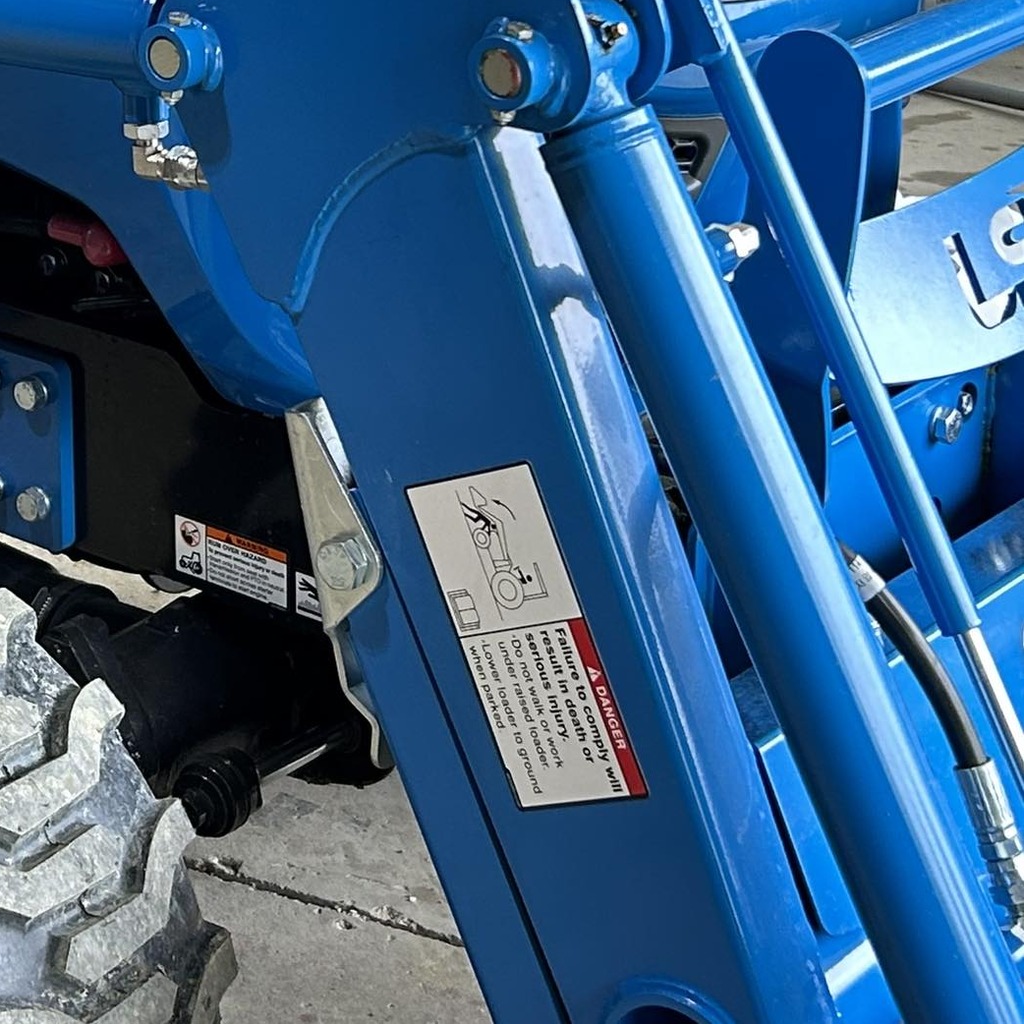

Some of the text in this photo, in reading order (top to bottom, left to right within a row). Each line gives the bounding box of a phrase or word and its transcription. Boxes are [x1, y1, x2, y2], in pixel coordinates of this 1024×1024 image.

[222, 544, 239, 555] OVER
[241, 552, 267, 564] HAZARD
[236, 538, 269, 554] WARNING
[469, 646, 486, 680] when
[498, 641, 517, 679] under
[513, 683, 534, 722] raised
[525, 633, 569, 741] serious injury.
[498, 687, 517, 727] loader
[519, 662, 533, 682] not
[528, 686, 544, 715] walk
[540, 720, 550, 733] or
[547, 737, 563, 768] work
[540, 631, 594, 763] result in death or
[555, 628, 623, 792] Failure to comply will
[596, 686, 626, 749] DANGER
[513, 732, 523, 744] to
[517, 748, 543, 794] ground
